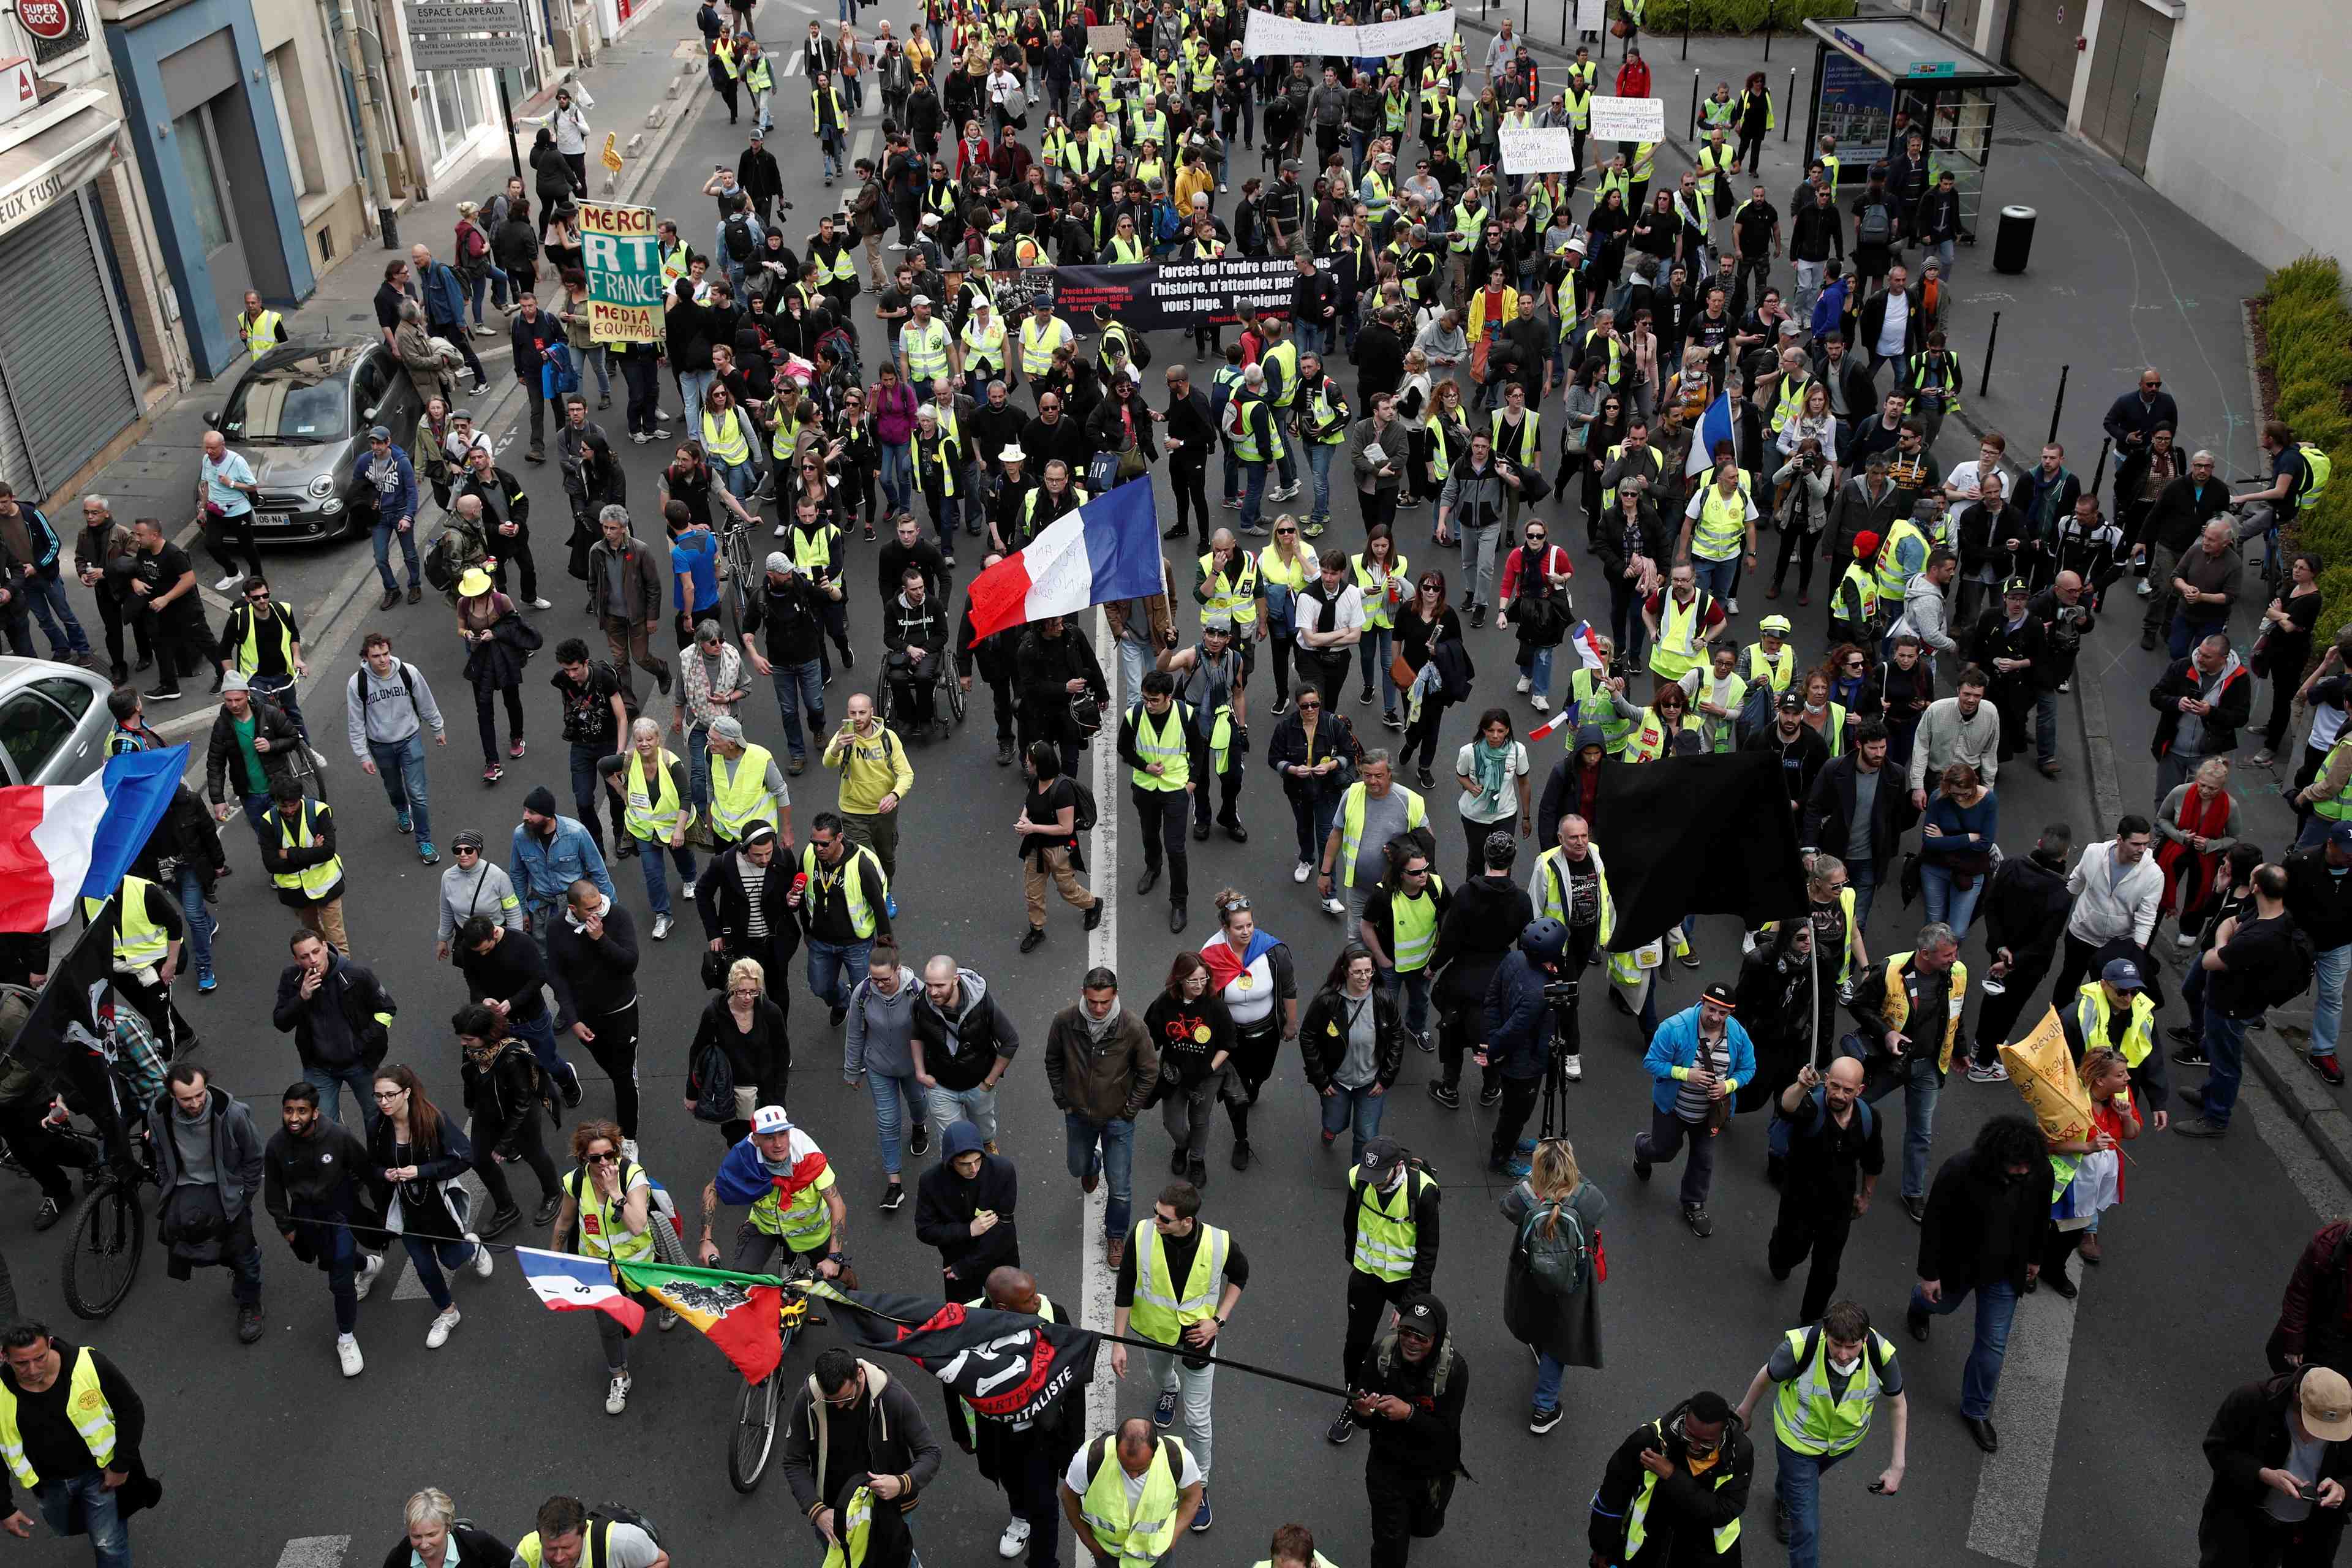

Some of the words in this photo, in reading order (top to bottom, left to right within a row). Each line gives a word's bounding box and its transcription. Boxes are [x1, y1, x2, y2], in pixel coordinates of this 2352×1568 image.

[22, 3, 58, 15] SUPER
[28, 12, 60, 24] BOCK
[418, 9, 452, 17] ESPACE
[455, 7, 505, 16] CARPEAUX
[584, 234, 655, 272] RT
[1159, 263, 1200, 278] Forces
[1202, 263, 1217, 276] de
[1219, 260, 1260, 275] l'ordre
[1262, 258, 1297, 273] entre
[588, 270, 663, 304] FRANCE
[1151, 282, 1208, 296] l'histoire,
[1210, 278, 1273, 293] n'attendez
[1161, 300, 1191, 312] vous
[1192, 297, 1223, 314] juge.
[897, 616, 933, 626] Kawasaki
[367, 686, 410, 706] COLUMBIA
[981, 1366, 1073, 1423] APITALISTE
